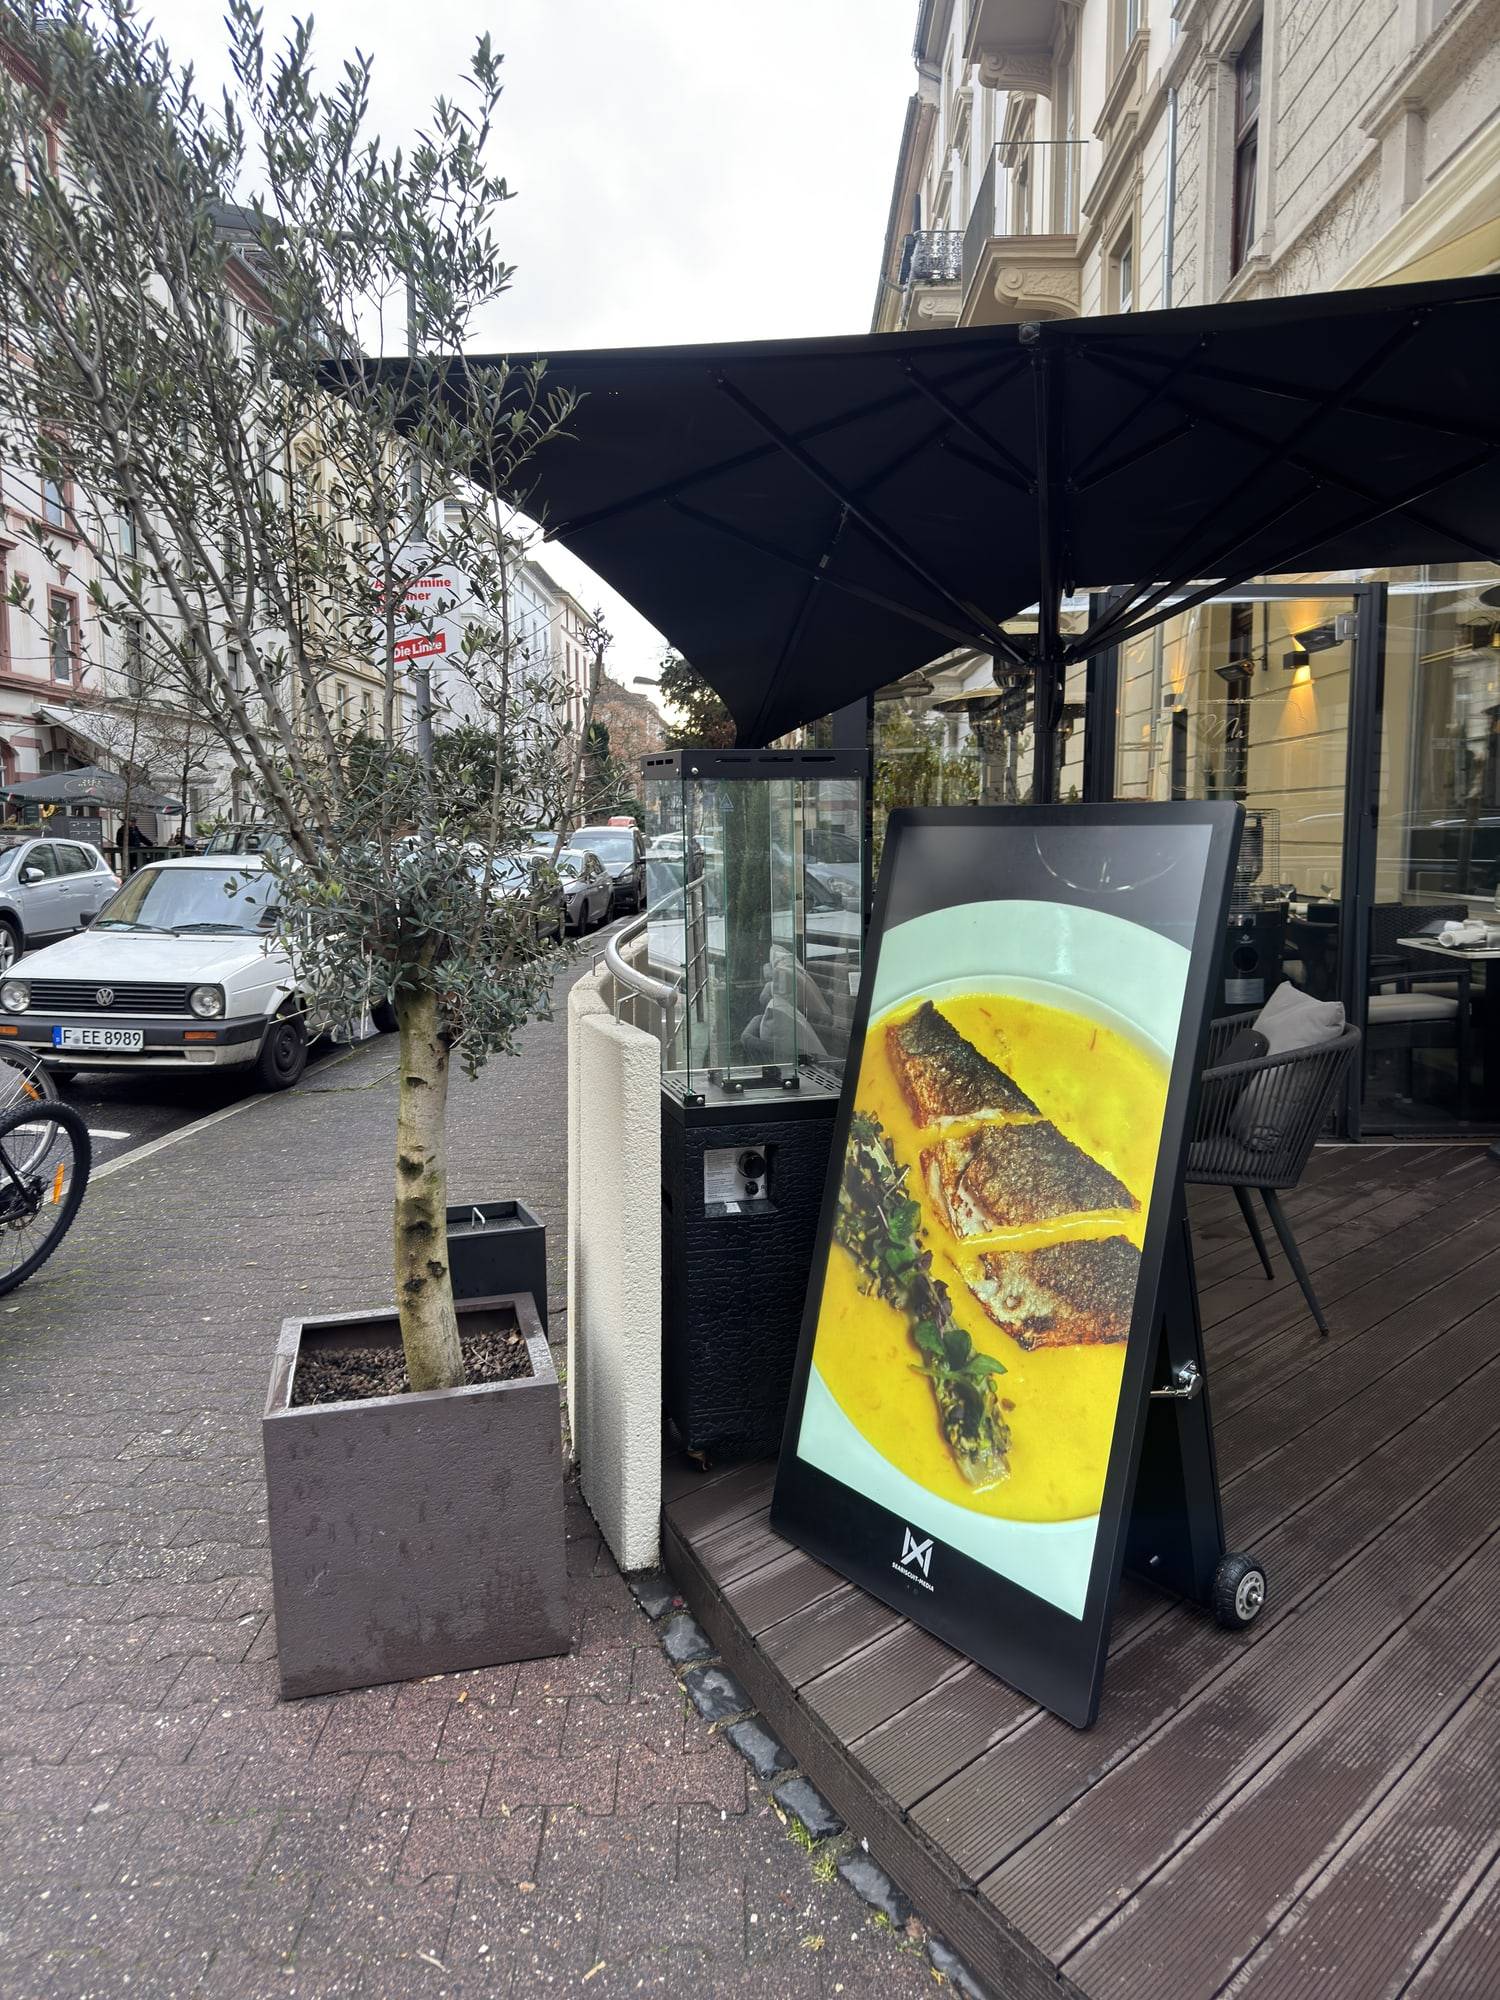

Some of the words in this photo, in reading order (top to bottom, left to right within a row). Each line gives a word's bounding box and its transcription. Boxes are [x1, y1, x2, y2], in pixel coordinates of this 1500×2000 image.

[394, 645, 411, 659] Die
[63, 1029, 72, 1043] F
[82, 1030, 101, 1045] EE
[104, 1031, 141, 1047] 8989
